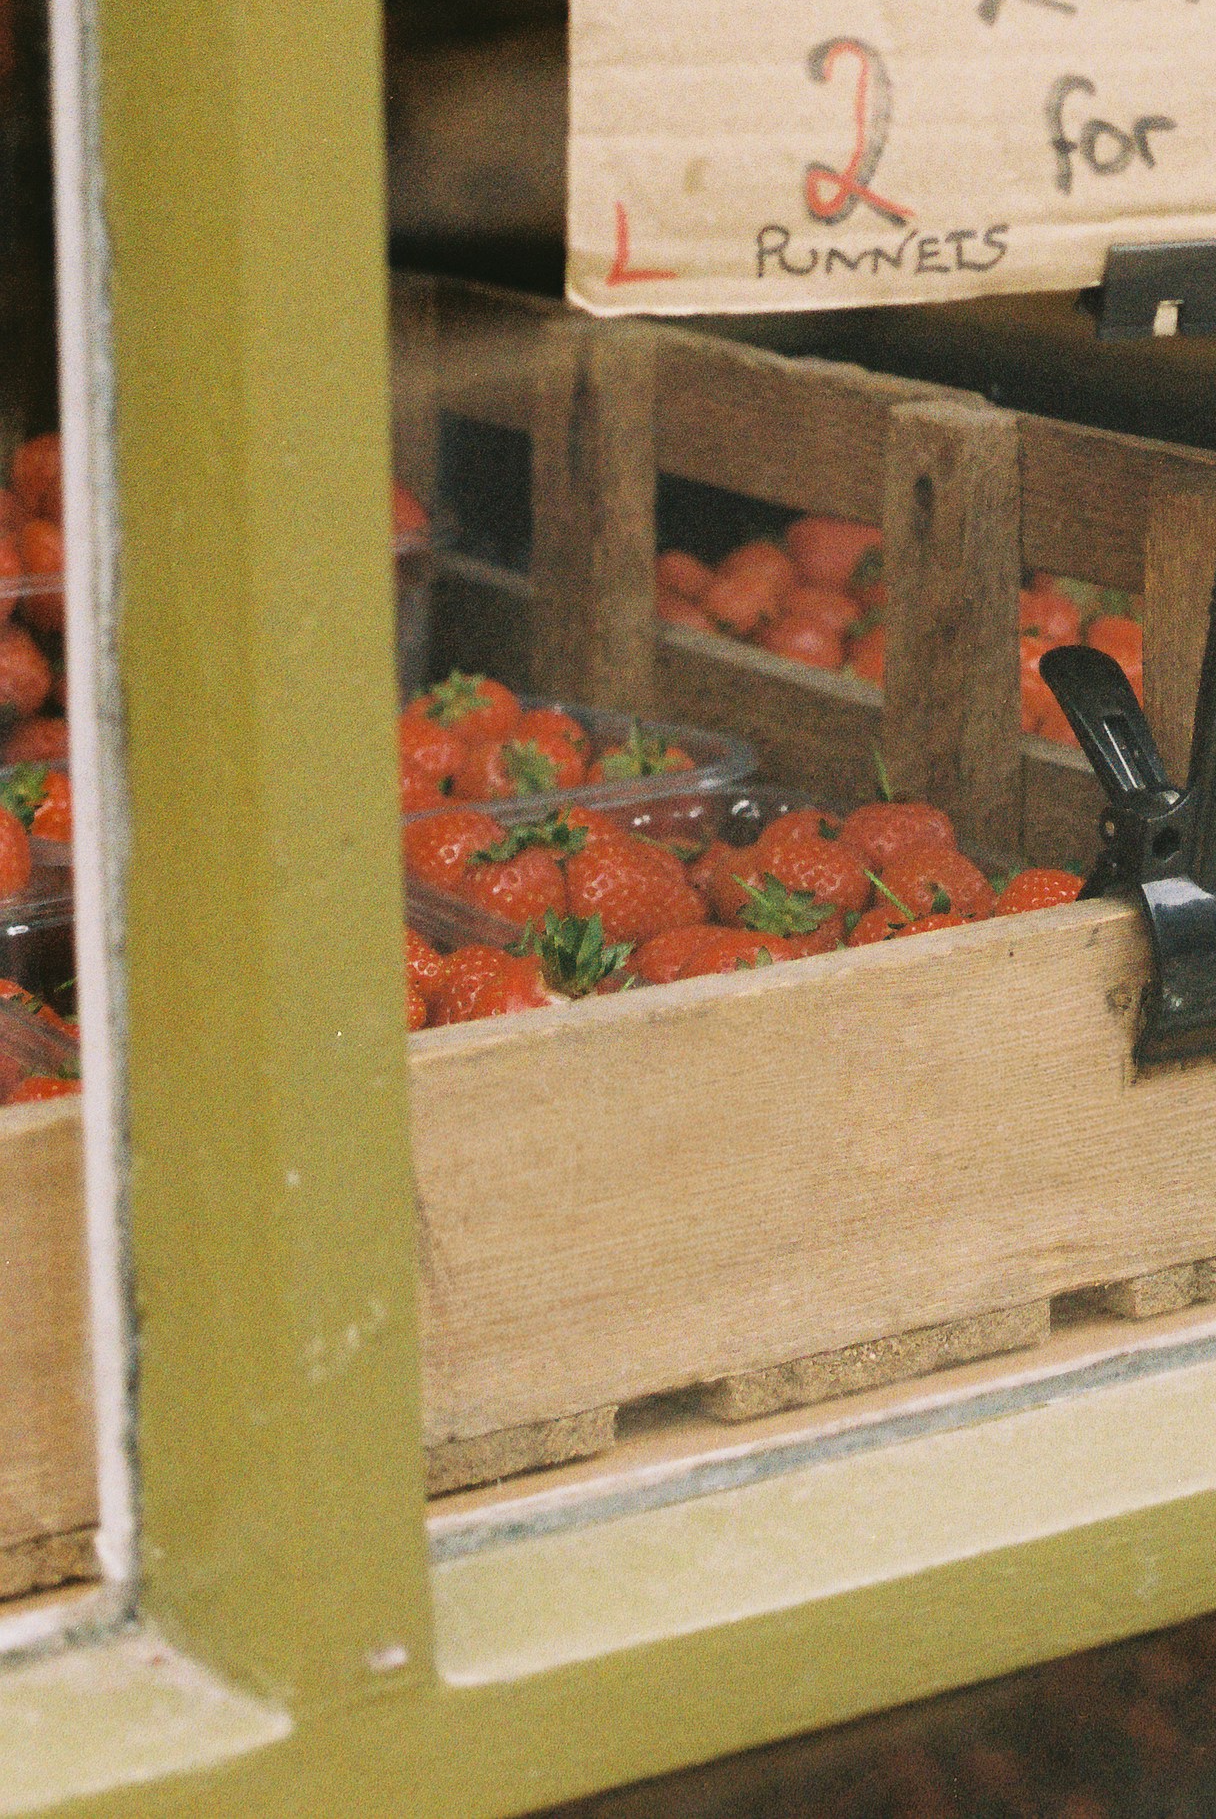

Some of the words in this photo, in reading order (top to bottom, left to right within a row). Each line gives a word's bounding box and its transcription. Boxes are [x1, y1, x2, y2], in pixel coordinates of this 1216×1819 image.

[803, 35, 916, 226] 2
[1044, 74, 1180, 196] for
[756, 223, 1010, 279] PUNNETS
